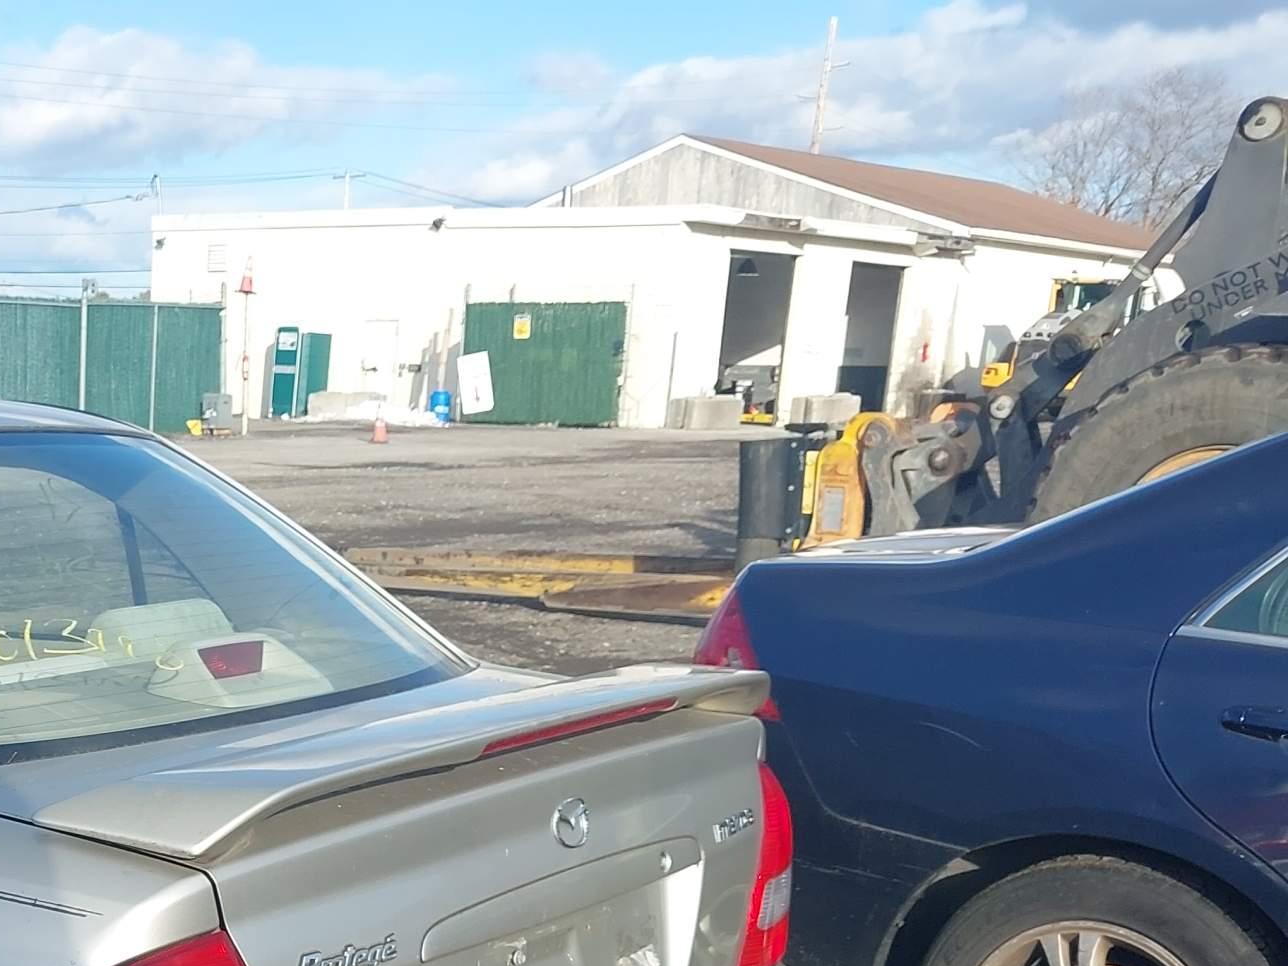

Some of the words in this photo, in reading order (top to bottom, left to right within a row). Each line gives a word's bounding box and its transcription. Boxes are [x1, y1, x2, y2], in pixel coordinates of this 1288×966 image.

[1172, 289, 1205, 314] DO
[1211, 262, 1261, 296] NOT
[1191, 279, 1268, 320] UNDER
